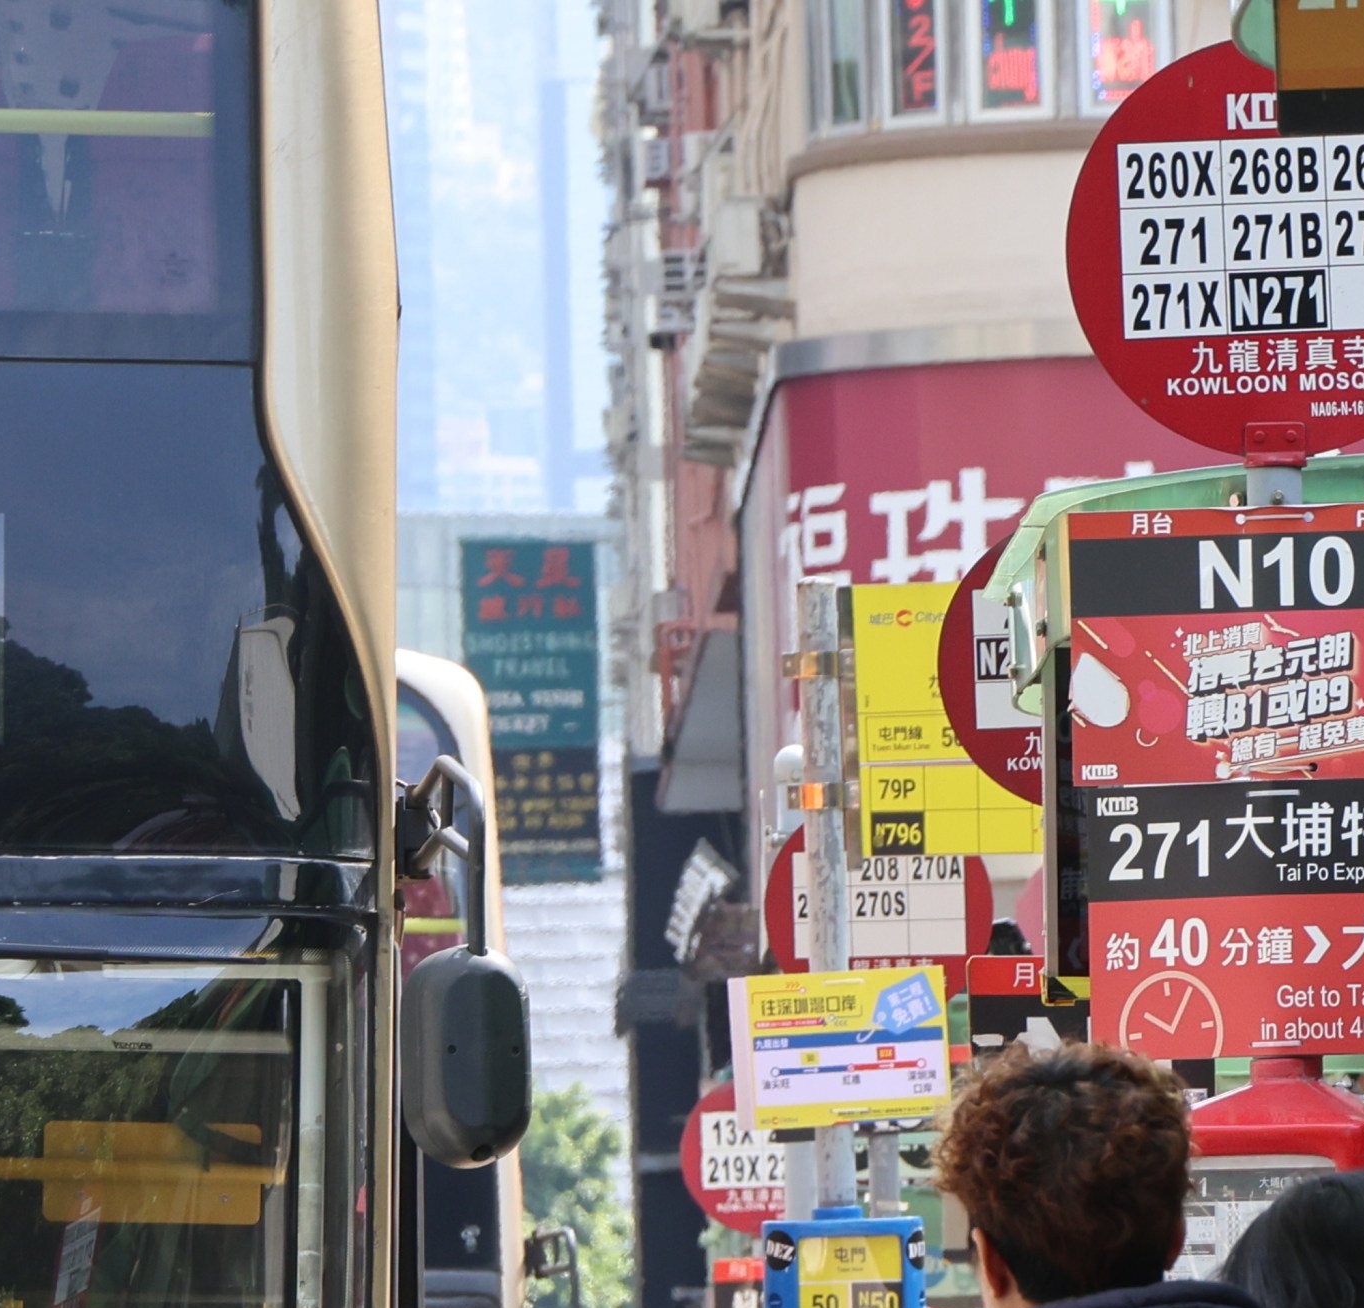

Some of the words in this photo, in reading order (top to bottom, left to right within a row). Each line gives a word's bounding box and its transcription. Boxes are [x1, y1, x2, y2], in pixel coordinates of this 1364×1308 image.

[1227, 93, 1279, 129] KM
[1126, 151, 1215, 199] 260X
[1230, 147, 1319, 196] 268B
[1140, 217, 1208, 265] 271
[1234, 212, 1322, 260] 271B
[1133, 280, 1221, 330] 271X
[1234, 274, 1326, 327] N271
[1167, 375, 1287, 396] KOWLOON
[1131, 513, 1173, 536] 月台
[1198, 536, 1355, 609] N10
[1183, 622, 1261, 656] 北上消費
[1186, 675, 1350, 740] 轉B1或B9
[879, 726, 923, 741] 屯門線
[1081, 765, 1118, 781] KMB
[879, 779, 916, 799] 79P
[1097, 796, 1138, 816] KMB
[876, 823, 921, 846] N796
[1108, 820, 1209, 881] 271
[861, 858, 898, 881] 208
[912, 856, 961, 880] 270A
[1276, 863, 1301, 881] Tai
[1306, 863, 1329, 881] Po
[856, 891, 905, 917] 270S
[1106, 932, 1140, 971] 約
[1149, 918, 1208, 967] 40
[1220, 926, 1294, 967] 分鐘
[1277, 985, 1316, 1008] Get
[1321, 986, 1340, 1008] to
[1261, 1018, 1277, 1041] in
[1284, 1019, 1344, 1041] about
[708, 1156, 760, 1183] 219X
[835, 1248, 866, 1263] 屯門
